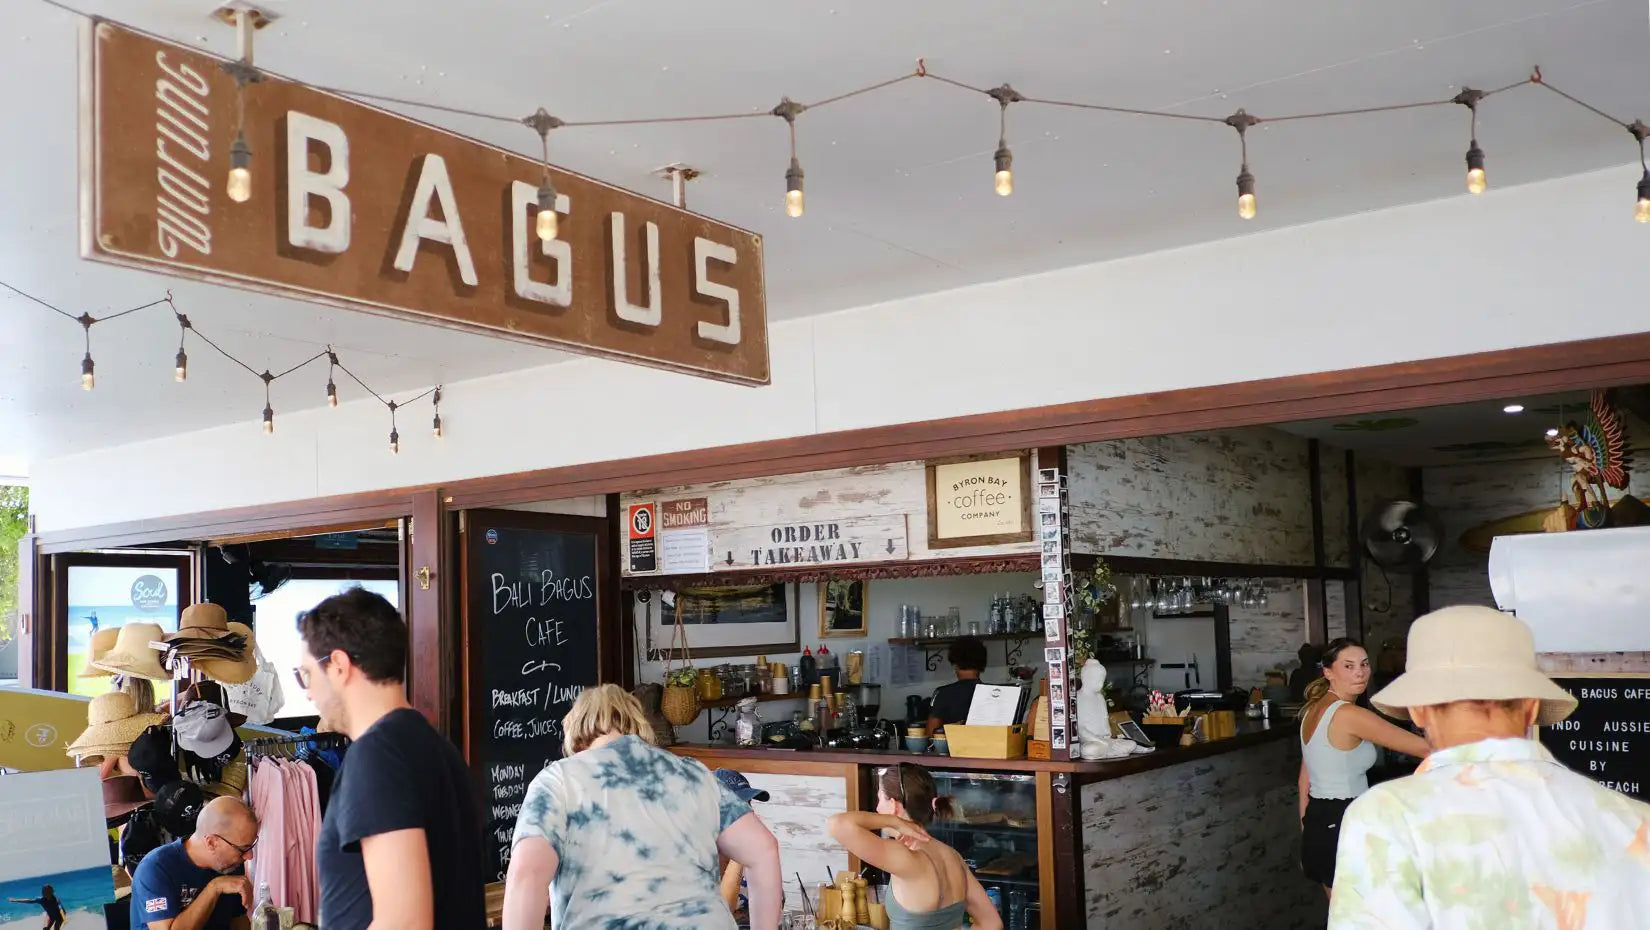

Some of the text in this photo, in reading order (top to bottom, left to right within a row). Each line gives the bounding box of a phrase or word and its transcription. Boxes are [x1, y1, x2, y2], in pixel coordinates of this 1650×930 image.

[286, 109, 742, 346] BAGUS
[952, 476, 1008, 491] BYRON BAY
[675, 501, 692, 512] NO
[953, 488, 1006, 509] coffee
[663, 508, 707, 527] SMOKING
[960, 511, 1001, 520] COMPANY
[771, 523, 841, 544] ORDER
[750, 541, 862, 566] TAKEAWAY
[133, 580, 165, 601] Soul
[491, 569, 593, 615] BALI BAGUS
[525, 616, 569, 647] CAFE
[491, 687, 541, 710] BREAKFAST
[1581, 688, 1618, 699] BAGUS
[1623, 688, 1650, 700] CAFE
[1603, 721, 1650, 733] AUSSIE
[1569, 740, 1630, 753] CUISINE
[491, 763, 525, 783] MONDAY
[1589, 760, 1607, 772] BY
